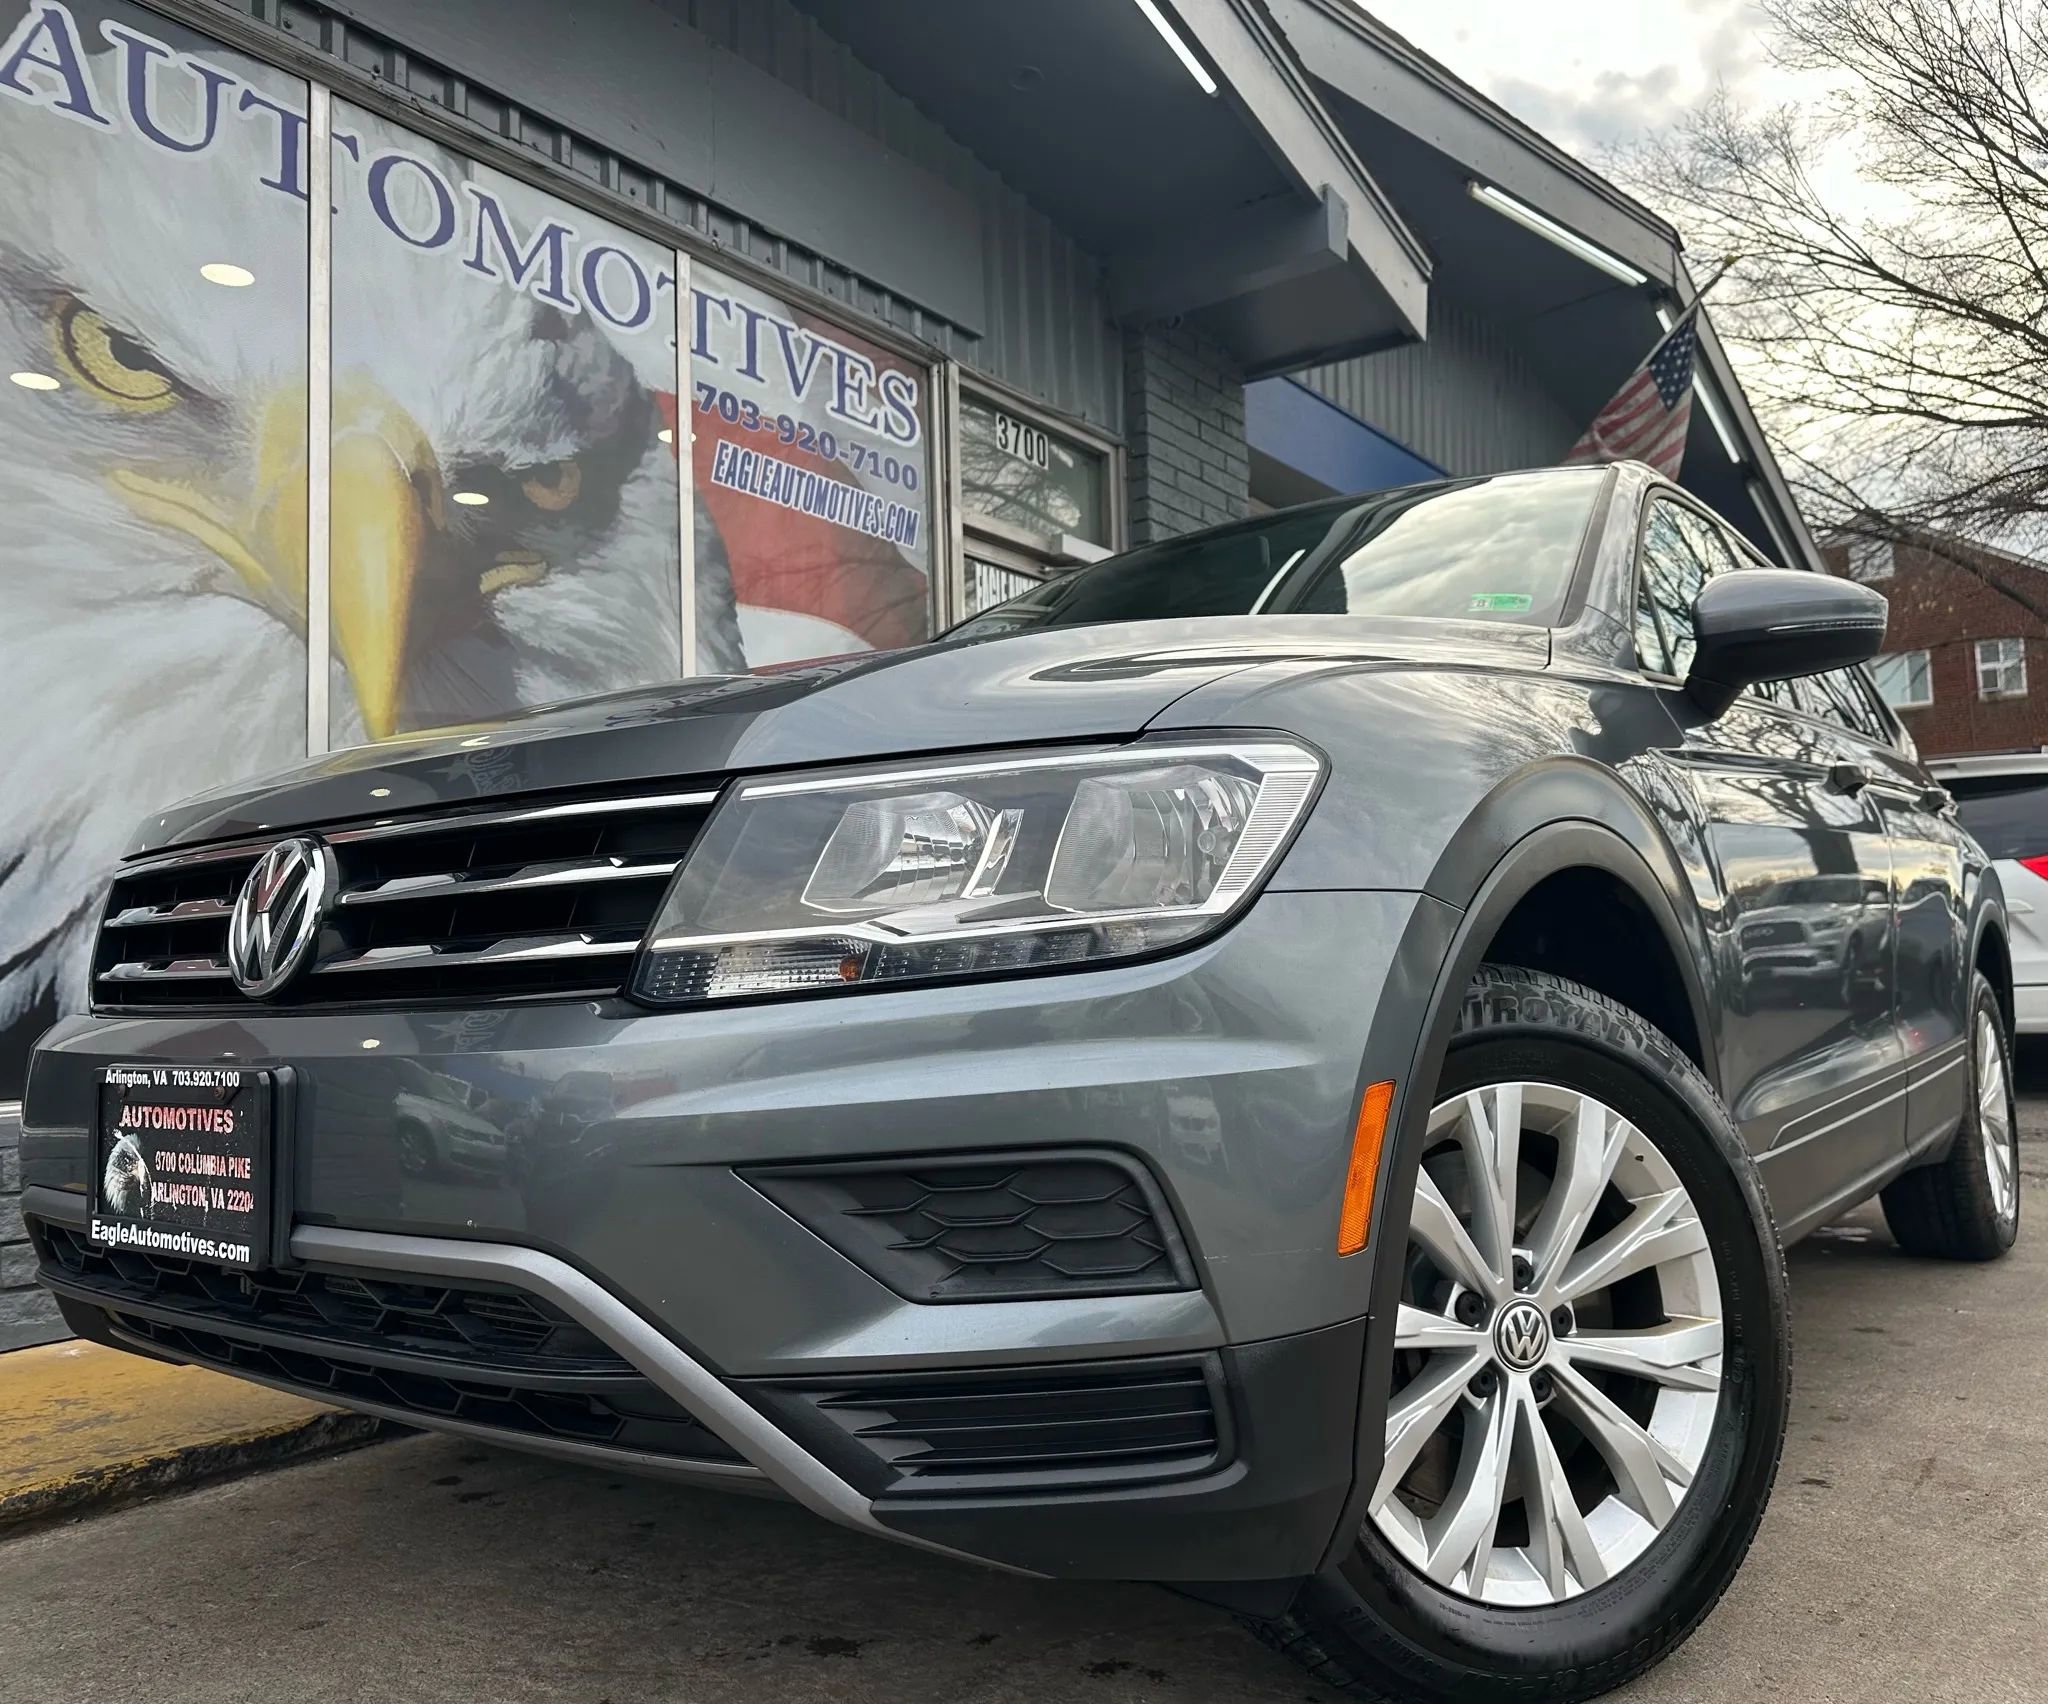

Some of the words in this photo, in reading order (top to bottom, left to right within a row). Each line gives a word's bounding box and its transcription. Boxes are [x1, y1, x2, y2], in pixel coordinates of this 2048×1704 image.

[0, 6, 921, 444] AUTOMOTIVES
[696, 380, 918, 492] 703-920-7100
[997, 414, 1048, 468] 3700
[712, 440, 920, 548] EAGLEAUTOMOTIVES.COM
[105, 1069, 151, 1088] Arlington,
[153, 1070, 168, 1085] VA
[172, 1071, 240, 1087] 703.920.7100
[119, 1105, 234, 1134] AUTOMOTIVES
[178, 1153, 226, 1177] COLUMBIA
[228, 1157, 251, 1179] PIKE
[211, 1188, 225, 1210] VA
[91, 1219, 250, 1263] EagleAutomotives.com
